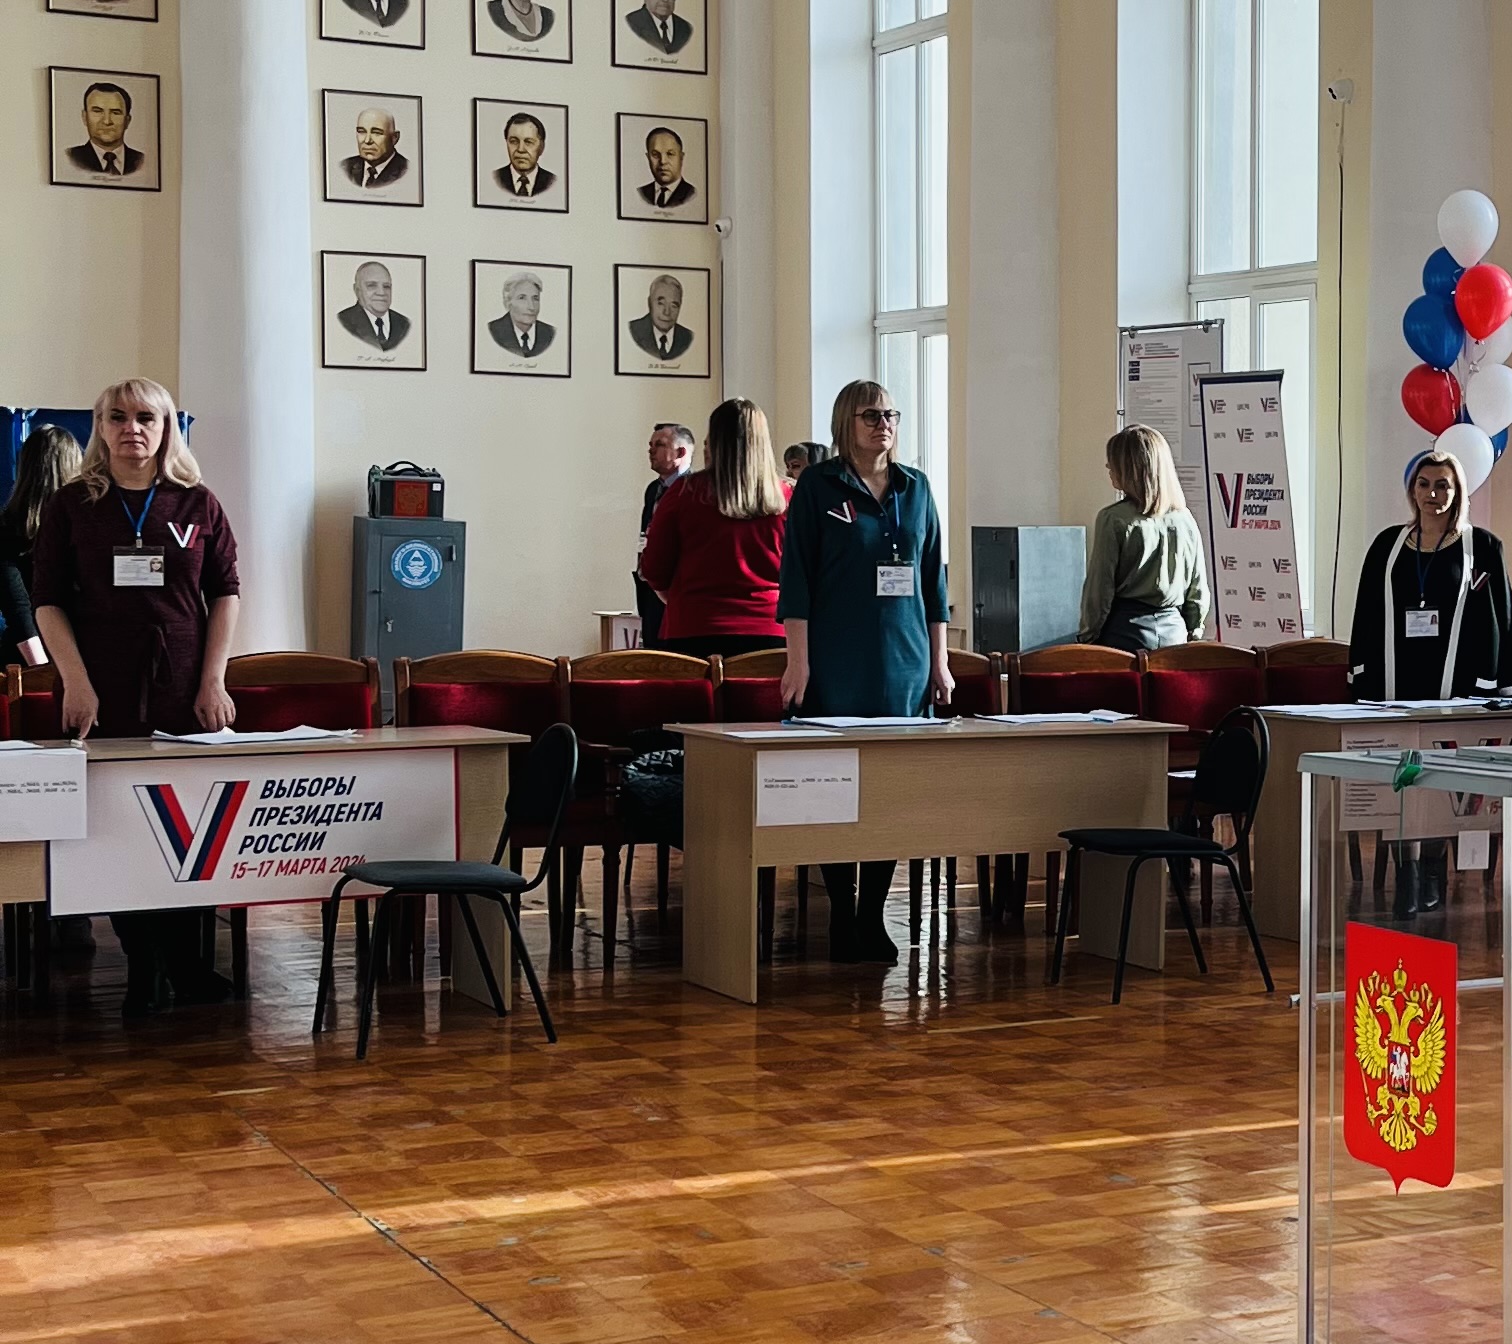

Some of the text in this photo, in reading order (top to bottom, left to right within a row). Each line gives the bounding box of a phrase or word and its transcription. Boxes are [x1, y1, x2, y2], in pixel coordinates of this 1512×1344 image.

[260, 776, 357, 799] ВЫБОРЫ
[249, 801, 383, 827] ПРЕЗИДЕНТА
[238, 831, 327, 855] РОССИИ
[275, 857, 327, 877] МАРТА
